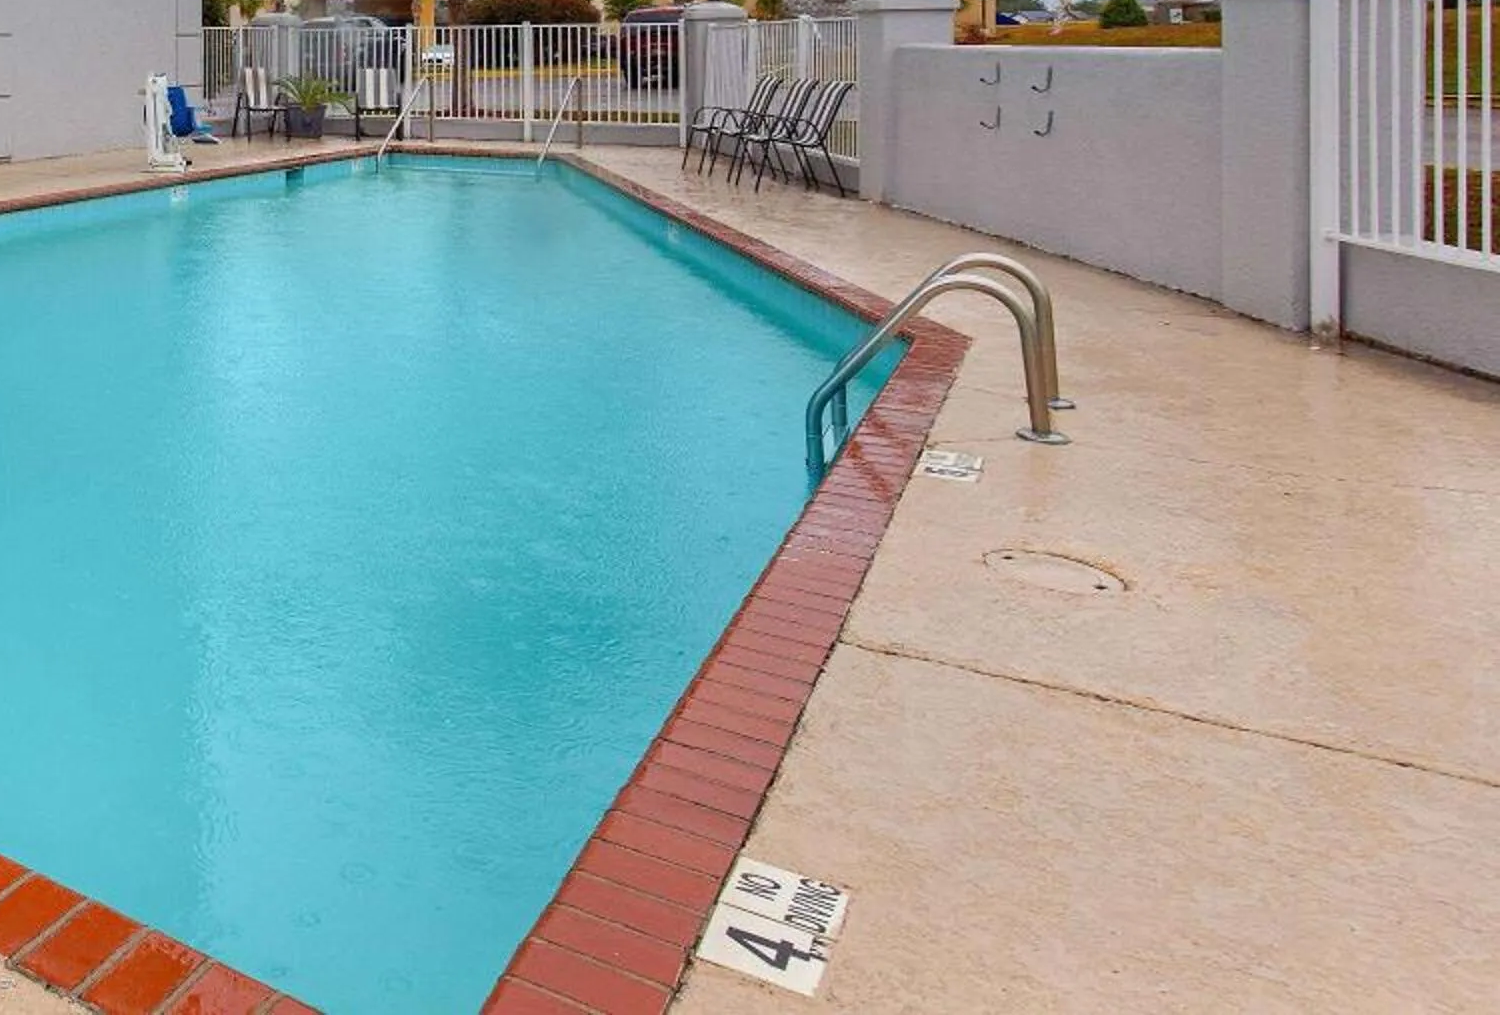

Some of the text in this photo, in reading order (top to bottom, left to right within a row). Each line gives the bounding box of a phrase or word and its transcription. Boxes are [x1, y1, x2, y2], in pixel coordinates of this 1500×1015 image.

[735, 872, 782, 902] NO
[784, 878, 842, 934] DIVING
[726, 926, 811, 971] 4
